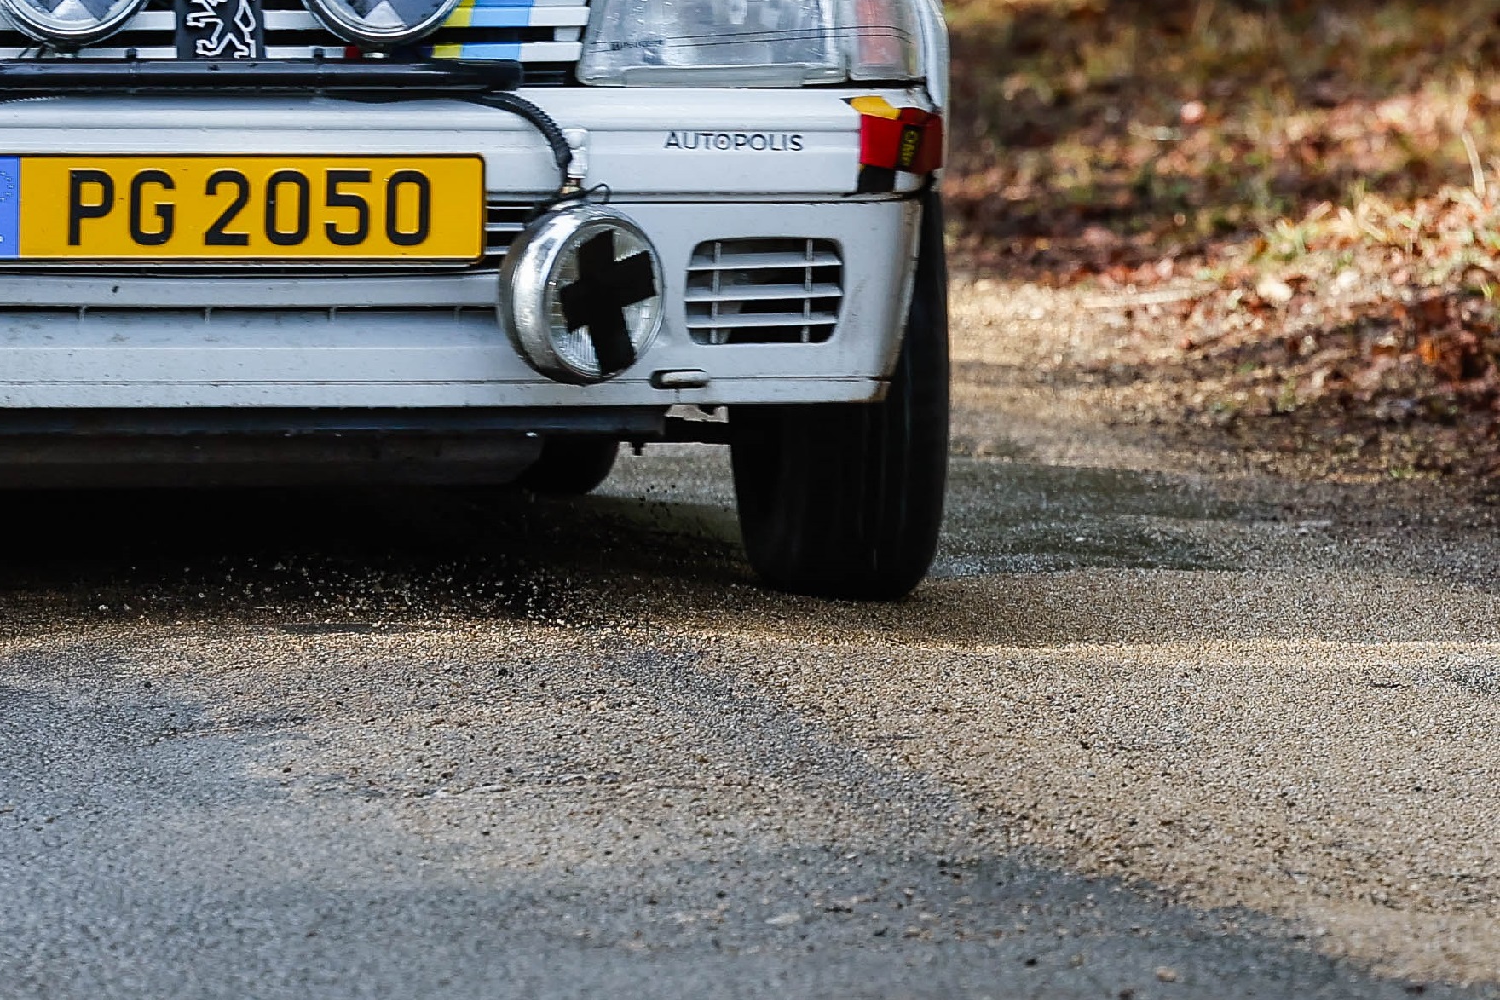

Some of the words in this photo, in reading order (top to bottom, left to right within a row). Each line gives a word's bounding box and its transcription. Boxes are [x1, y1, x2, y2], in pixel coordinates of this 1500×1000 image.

[665, 131, 804, 152] AUTOPOLIS
[69, 169, 176, 247] PG
[204, 169, 432, 247] 2050
